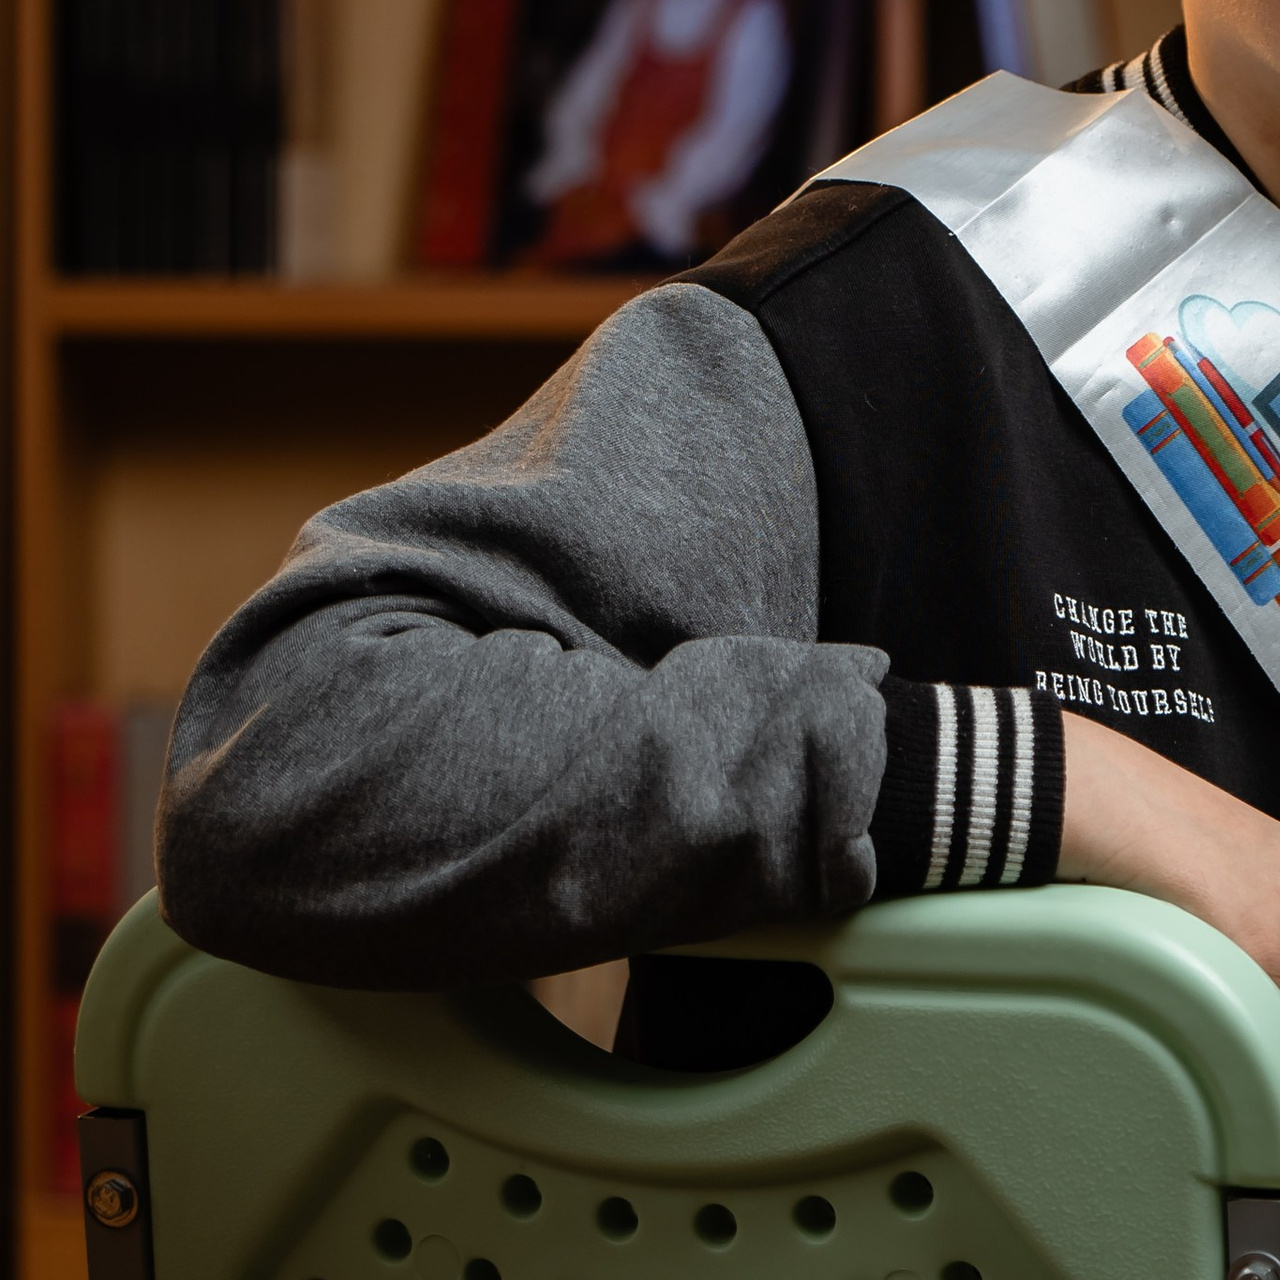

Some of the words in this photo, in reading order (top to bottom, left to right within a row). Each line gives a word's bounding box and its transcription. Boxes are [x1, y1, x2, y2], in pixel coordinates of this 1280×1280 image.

[1053, 592, 1136, 636] CHANGE
[1144, 608, 1189, 639] THE
[1069, 630, 1139, 672] WORLD
[1150, 643, 1181, 672] BY
[1035, 670, 1104, 706] BEING
